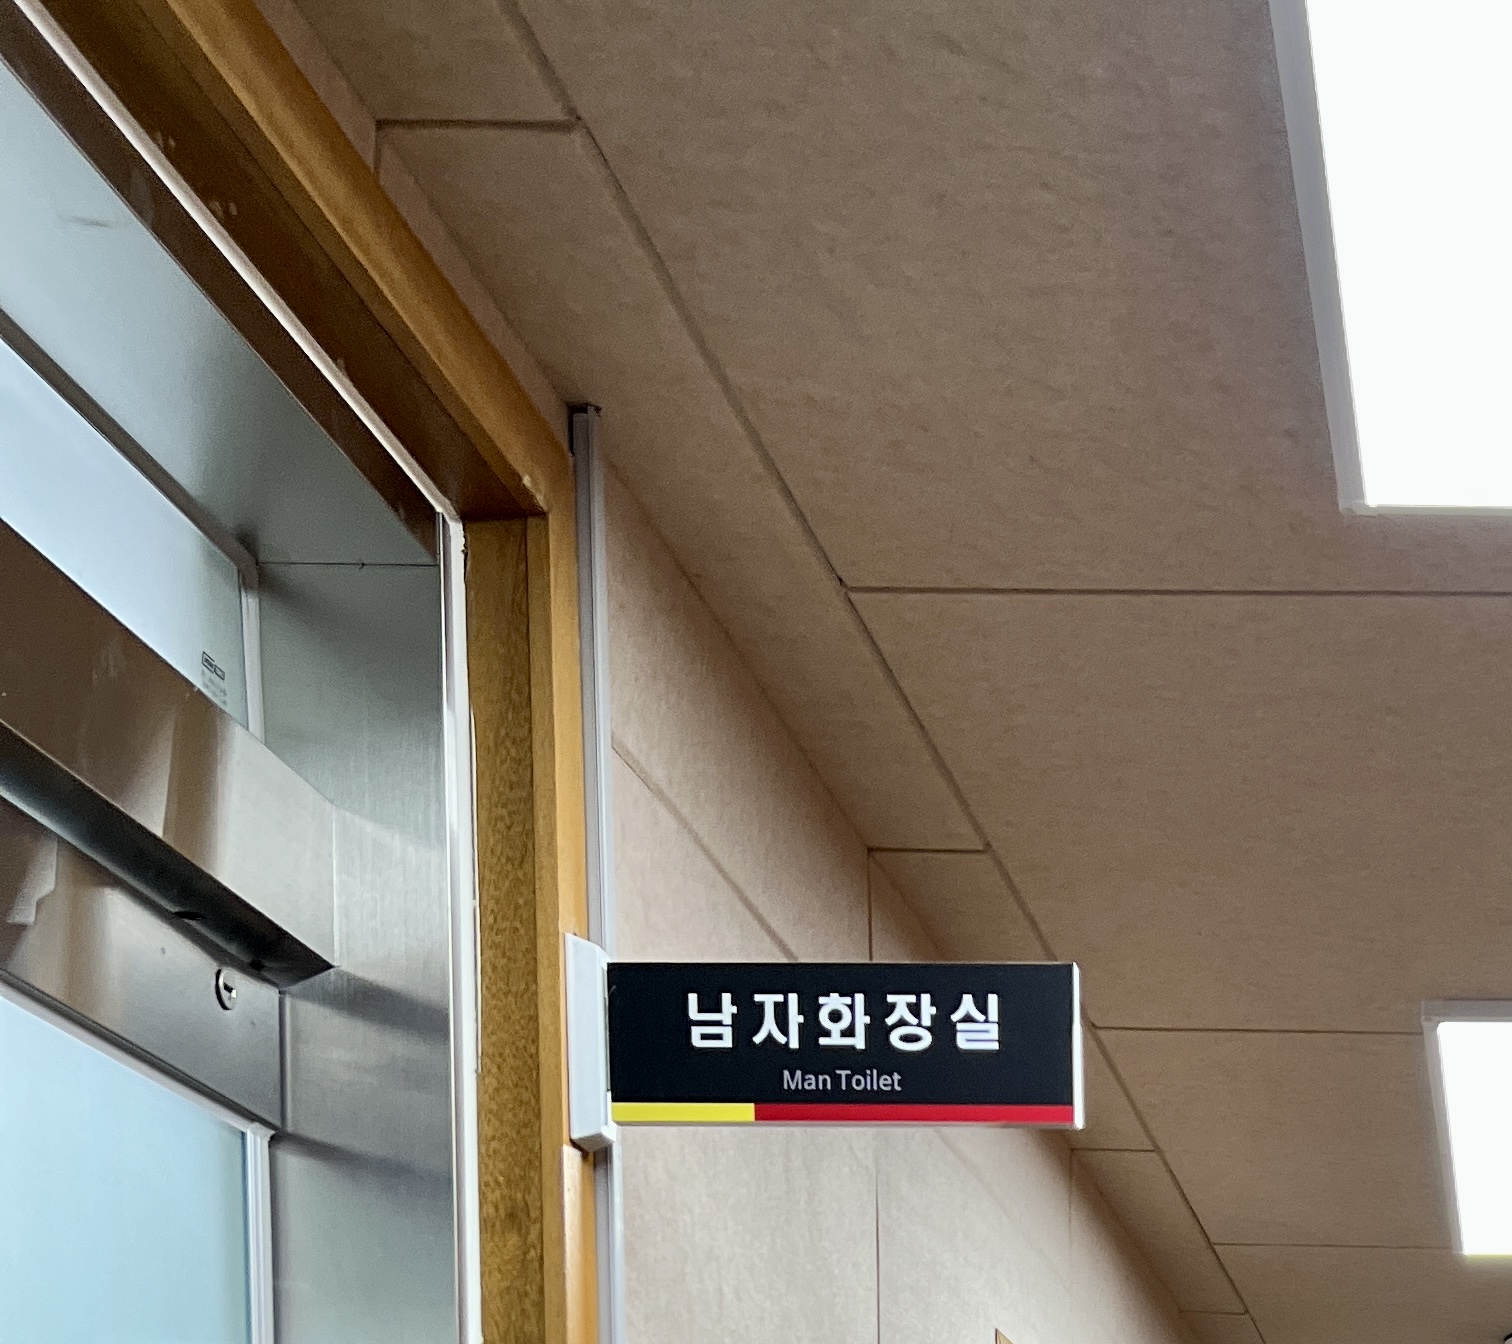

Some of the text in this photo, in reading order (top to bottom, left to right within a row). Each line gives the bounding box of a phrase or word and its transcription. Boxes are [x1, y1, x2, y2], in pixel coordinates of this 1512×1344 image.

[687, 992, 1001, 1051] 남자화장실
[783, 1069, 902, 1092] Man Toilet
